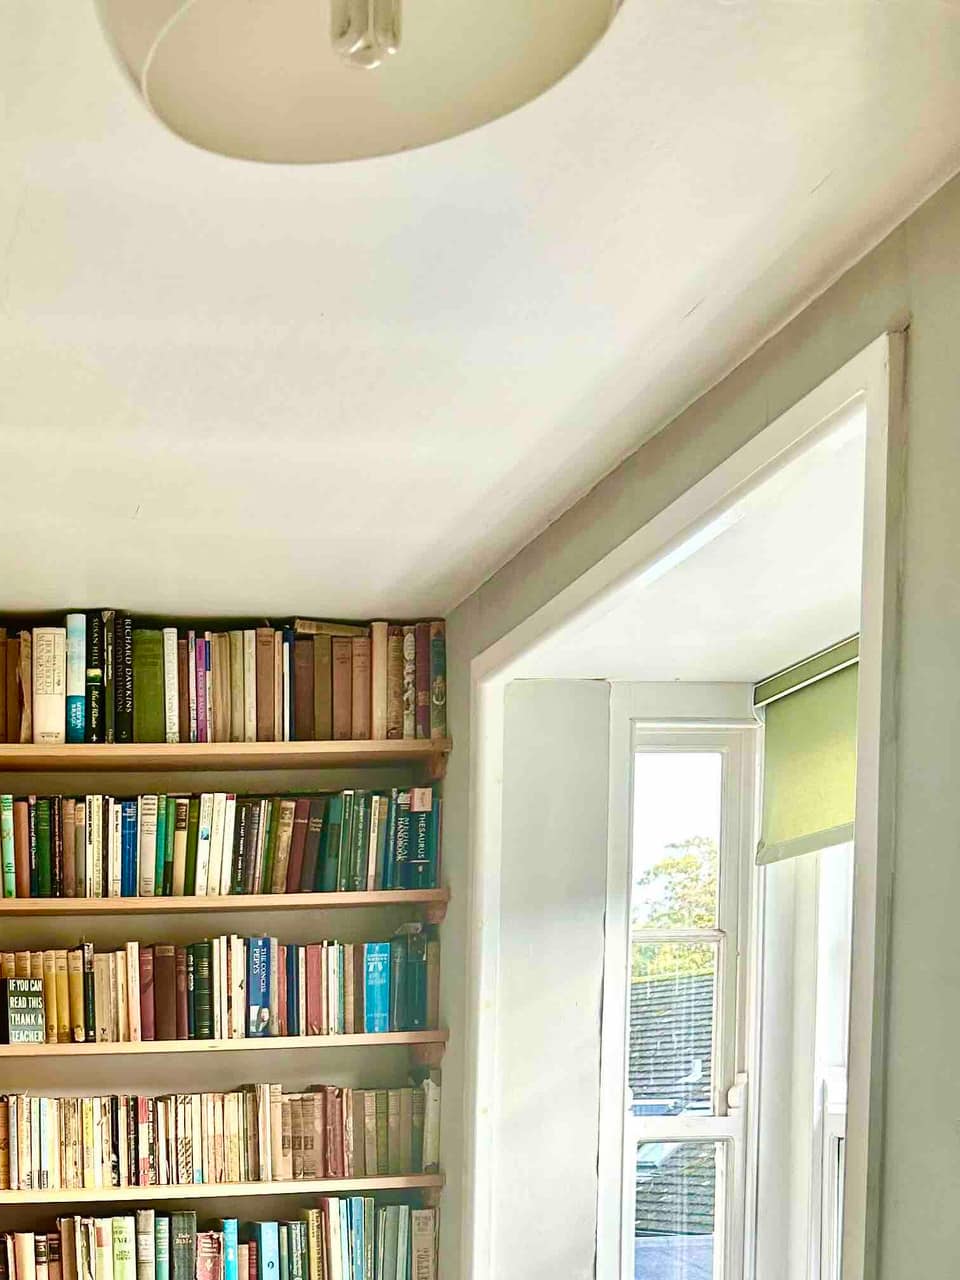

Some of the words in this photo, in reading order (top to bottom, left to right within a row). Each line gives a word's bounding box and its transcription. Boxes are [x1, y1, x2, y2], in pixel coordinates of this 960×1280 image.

[125, 668, 133, 713] DAWKINS
[396, 817, 405, 862] HANDBOOK
[418, 813, 426, 858] THESAURUS
[9, 980, 16, 991] IF
[16, 980, 29, 991] YOU
[30, 980, 42, 991] CAN
[10, 996, 27, 1009] READ
[28, 996, 43, 1009] THIS
[11, 1013, 36, 1025] THANK
[37, 1013, 43, 1025] A
[10, 1030, 44, 1042] TEACHER
